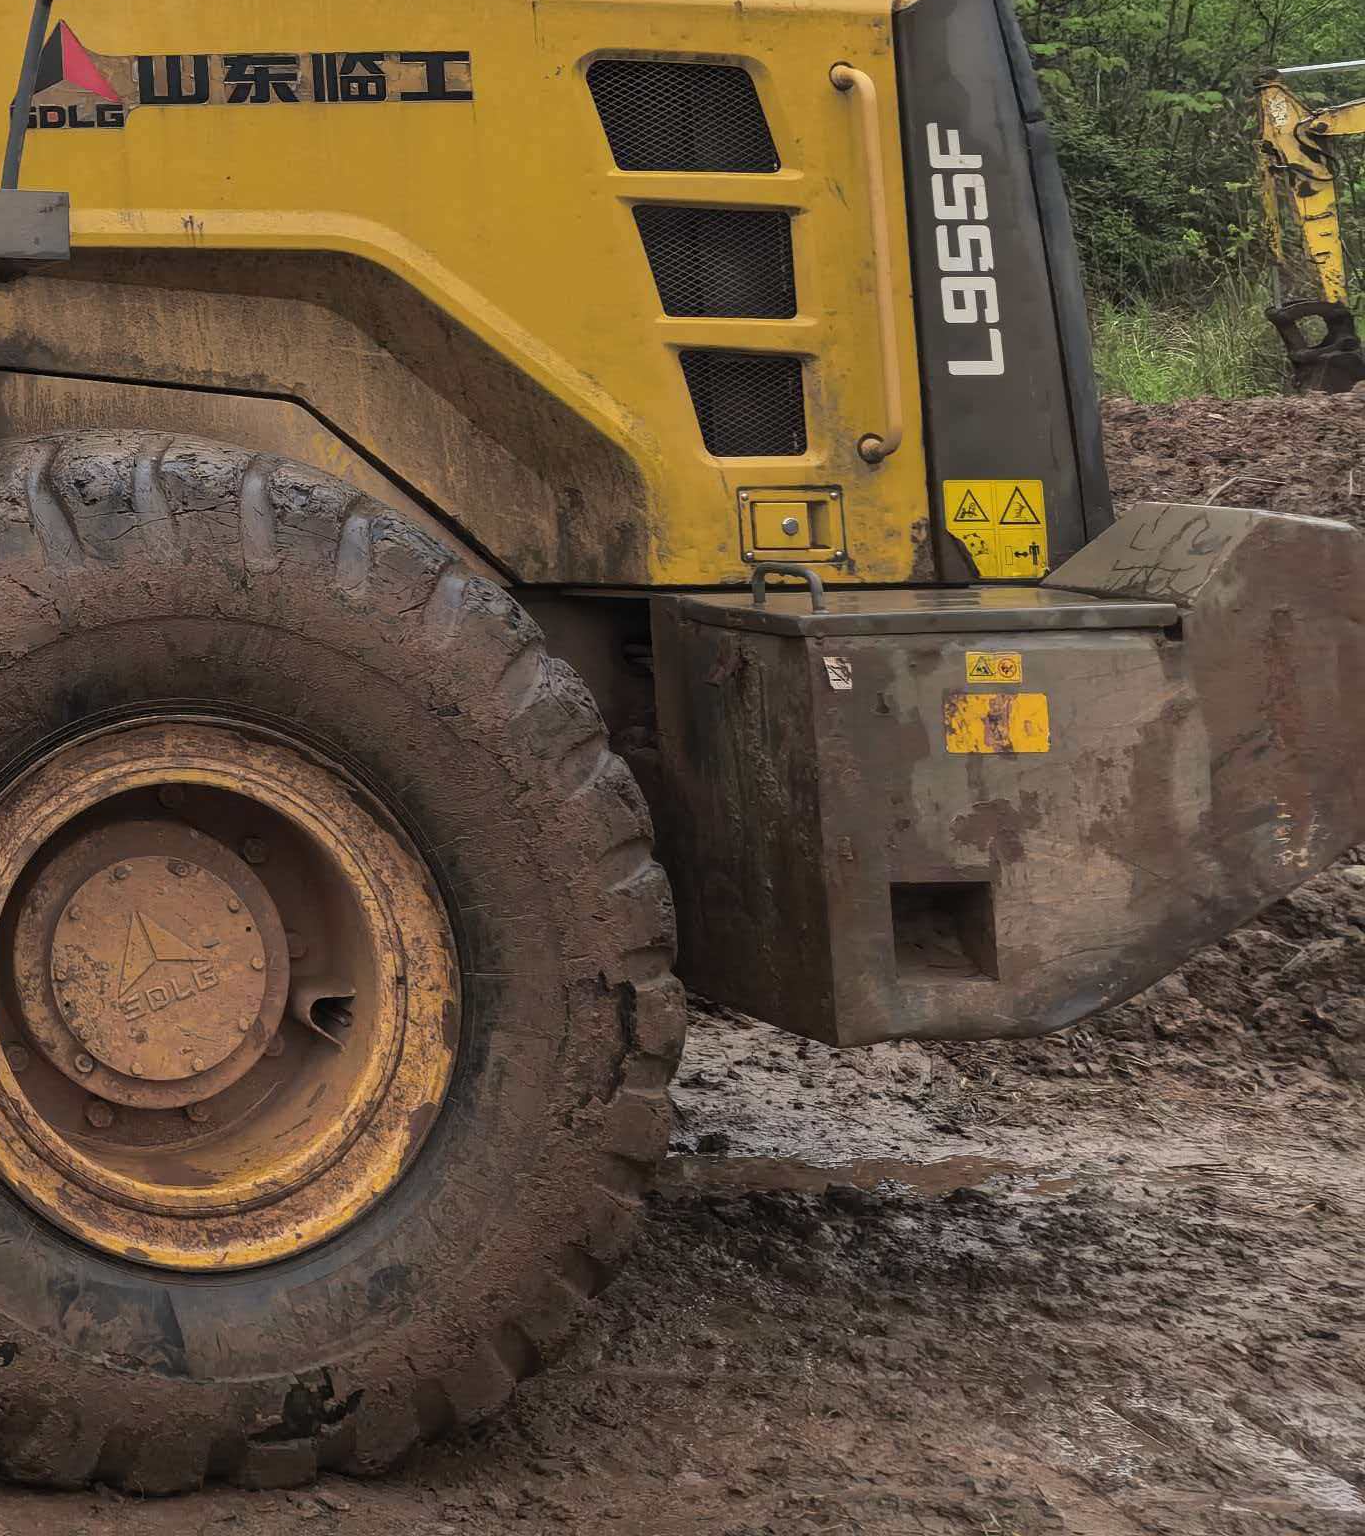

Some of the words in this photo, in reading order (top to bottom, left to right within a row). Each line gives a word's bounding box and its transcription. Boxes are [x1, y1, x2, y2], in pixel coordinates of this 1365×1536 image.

[137, 51, 473, 105] 山东临工
[925, 122, 1005, 376] L955F
